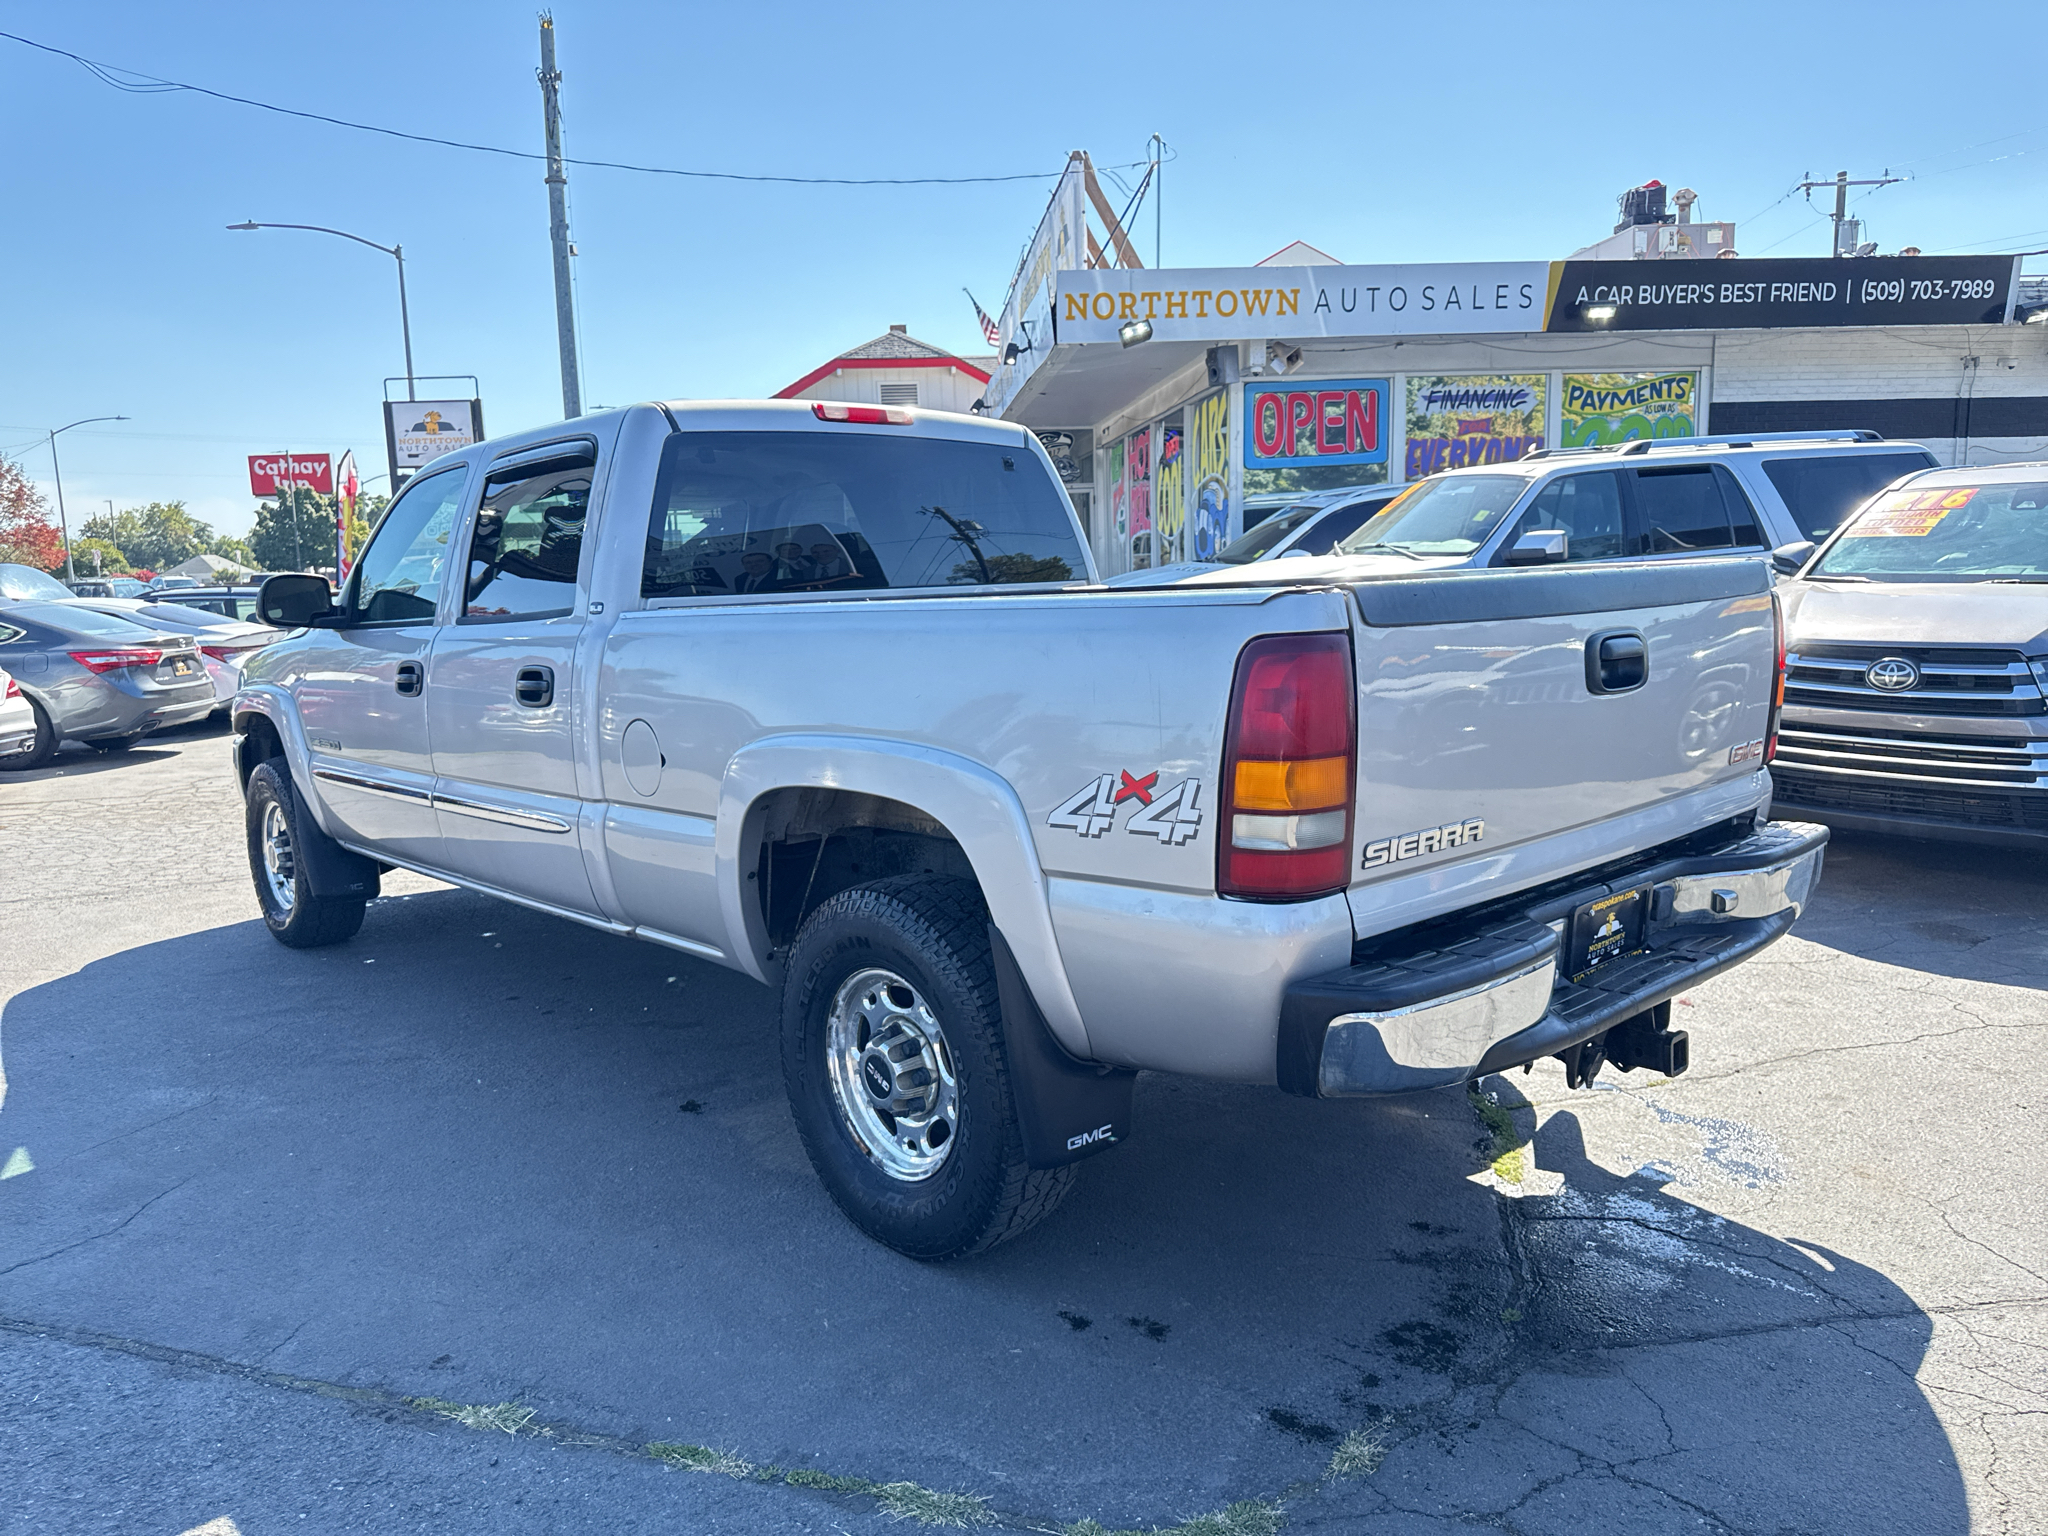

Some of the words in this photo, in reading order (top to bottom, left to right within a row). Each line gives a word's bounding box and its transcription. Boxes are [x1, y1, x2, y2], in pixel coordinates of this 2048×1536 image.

[1065, 288, 1300, 321] NORTHTOWN
[1314, 286, 1408, 314] AUTO
[1421, 283, 1533, 311] SALES
[1575, 285, 1589, 305] A
[1594, 285, 1634, 305] CAR
[1638, 283, 1715, 305] BUYER'S
[1719, 282, 1766, 303] BEST
[1770, 281, 1837, 302] FRIEND
[1861, 278, 1906, 304] (509)
[1910, 278, 1995, 300] 703-7989
[1425, 388, 1528, 412] FINANCING
[1568, 376, 1690, 412] PAYMENTS
[1644, 404, 1653, 414] AS
[1654, 404, 1667, 413] LOW
[1667, 403, 1676, 413] AS
[1253, 389, 1379, 458] OPEN
[1460, 421, 1488, 433] FOR
[398, 437, 472, 446] NORTHTOWN
[253, 457, 327, 477] Cathay
[1729, 738, 1763, 766] GMC
[1361, 816, 1485, 870] SIERRA
[1587, 948, 1605, 960] AUTO
[1606, 938, 1625, 953] SALES
[1588, 931, 1626, 953] NORTHTOWN
[867, 1061, 890, 1092] GMC
[1067, 1123, 1112, 1151] GMC
